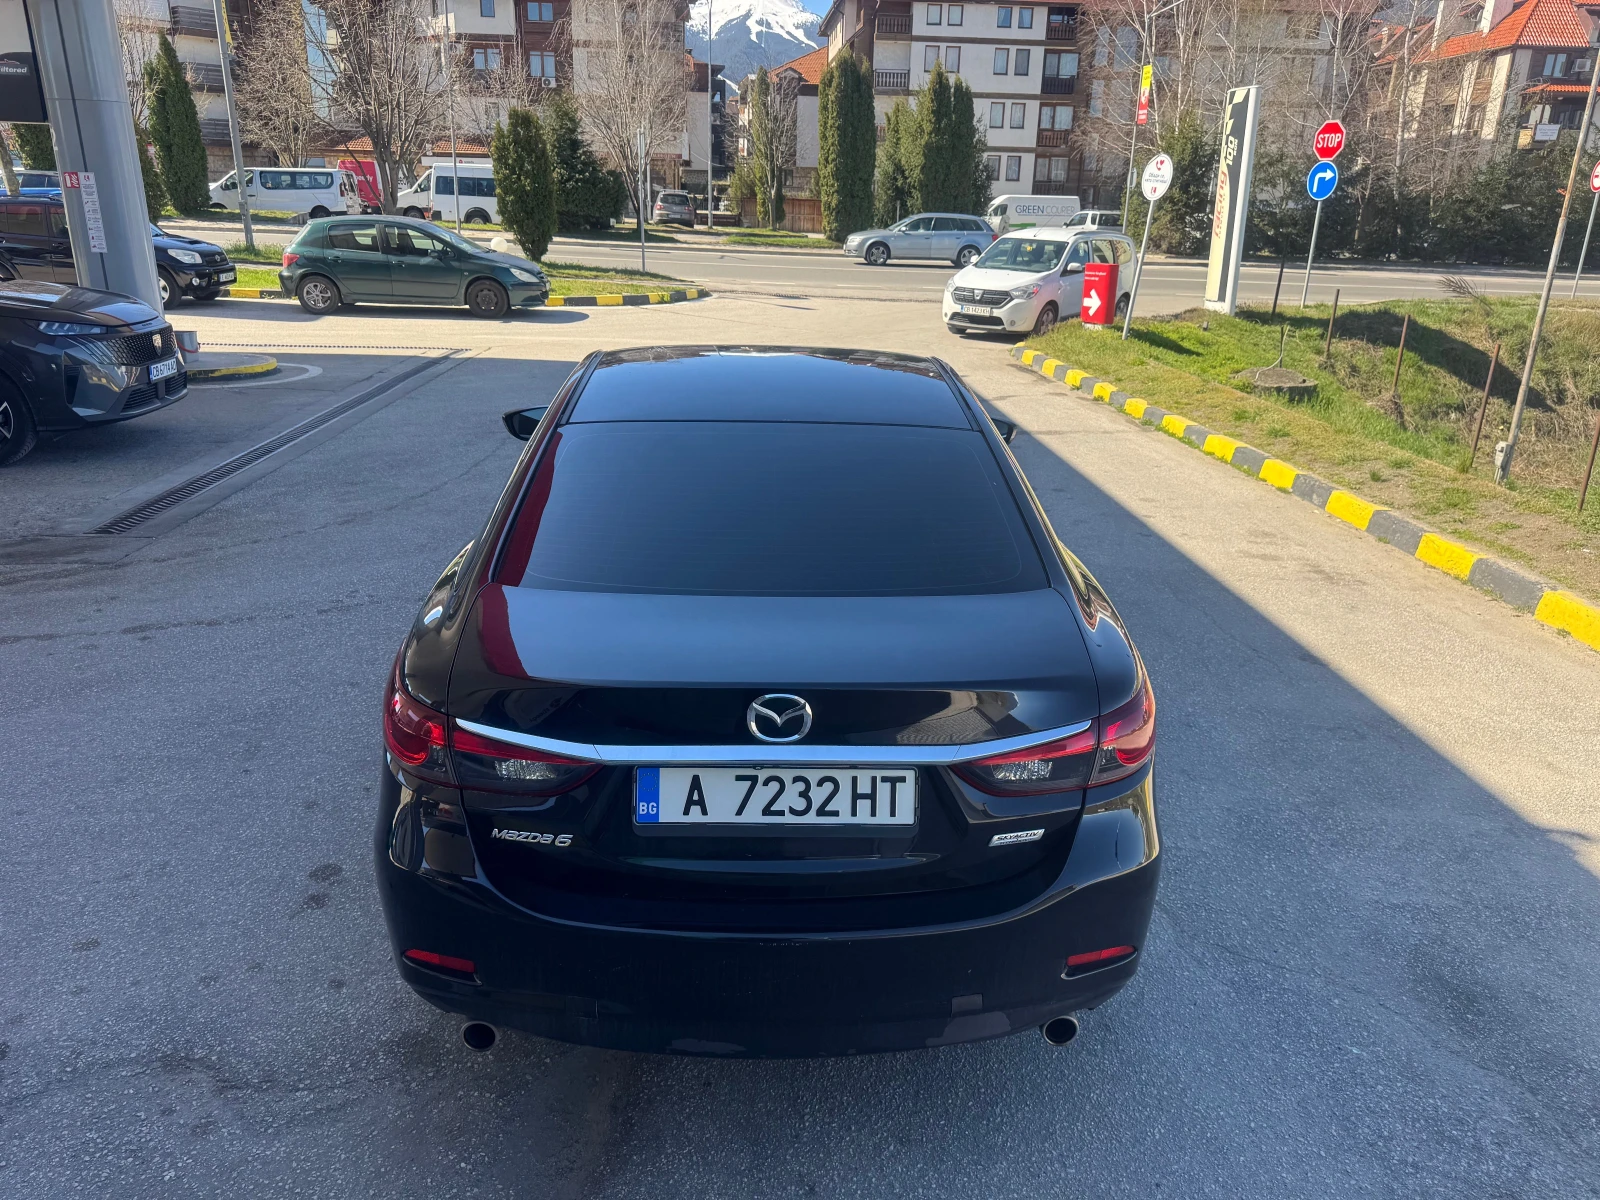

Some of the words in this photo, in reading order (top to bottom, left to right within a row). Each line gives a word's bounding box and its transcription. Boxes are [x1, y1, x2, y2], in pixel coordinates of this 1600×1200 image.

[1316, 133, 1342, 148] STOP
[1225, 135, 1235, 166] 100
[1015, 204, 1045, 214] GREEN
[153, 366, 160, 378] CB
[682, 774, 709, 816] A
[734, 775, 841, 818] 7232
[850, 775, 907, 818] HT
[639, 802, 657, 815] BG
[997, 831, 1040, 841] SKYACTIV
